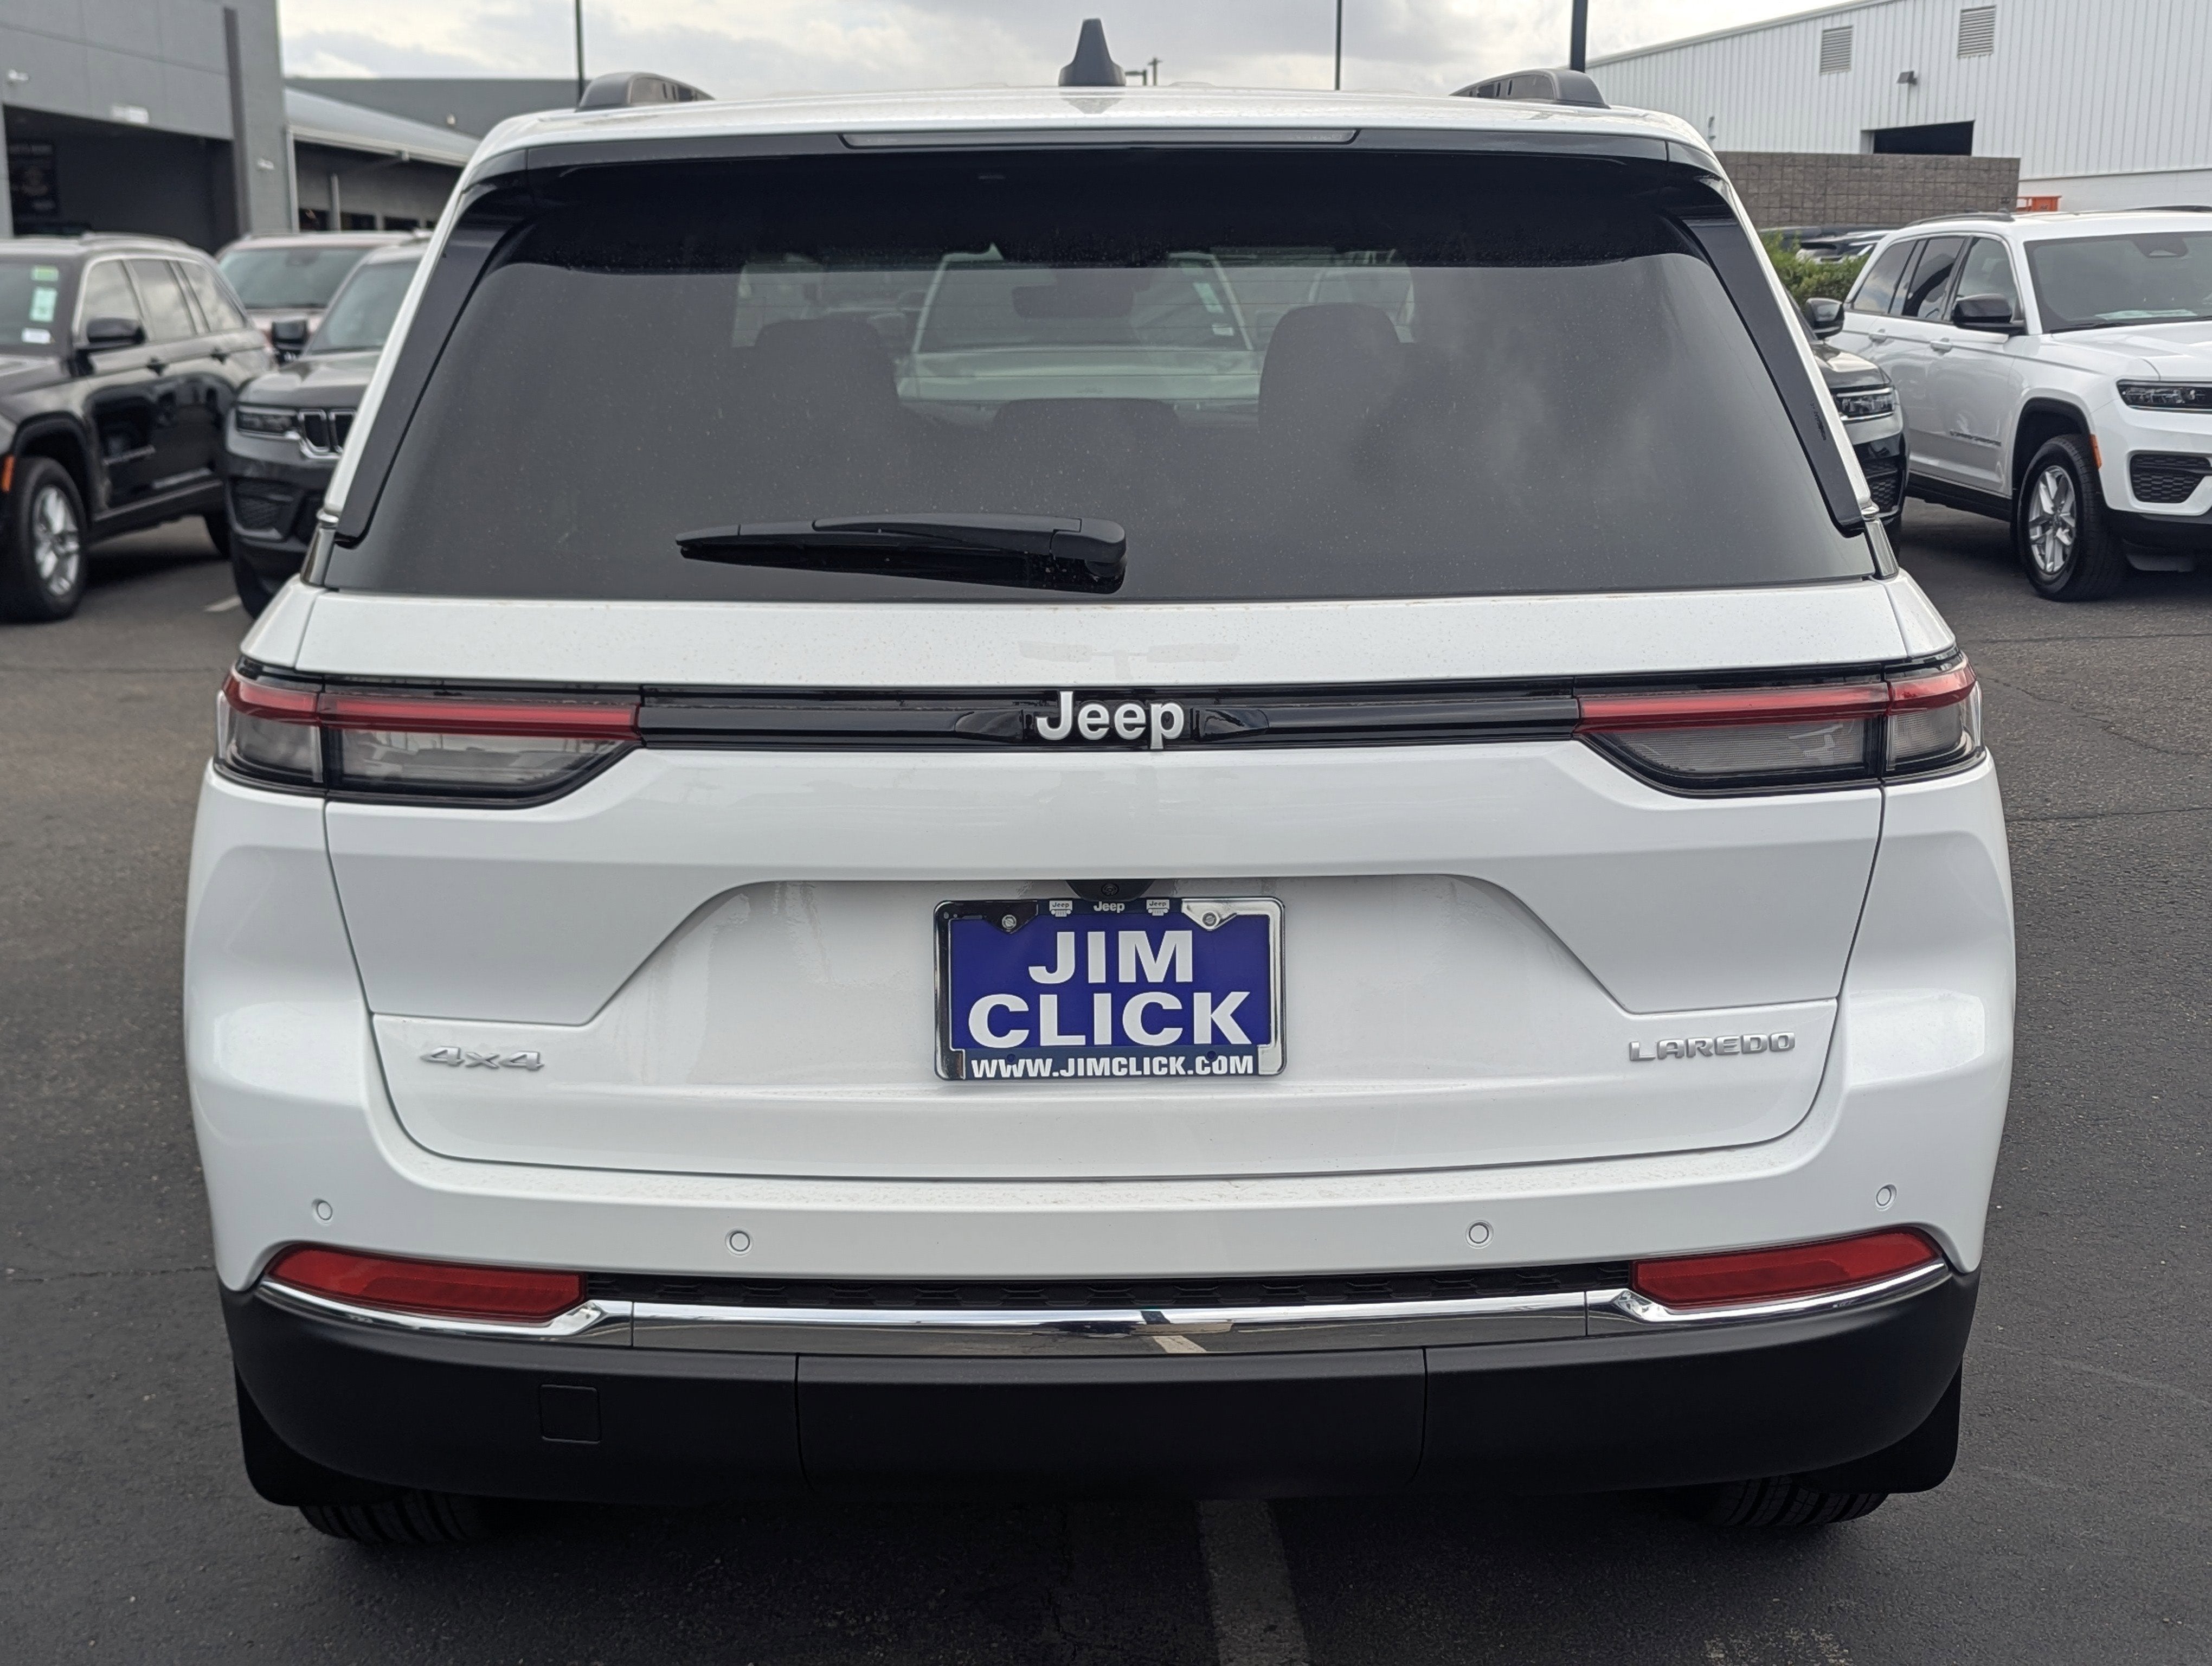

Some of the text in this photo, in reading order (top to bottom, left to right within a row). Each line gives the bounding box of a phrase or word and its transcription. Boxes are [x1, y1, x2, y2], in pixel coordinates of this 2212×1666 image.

[1036, 691, 1184, 749] Jeep
[1093, 901, 1125, 913] Jeep
[1028, 930, 1193, 984] JIM
[968, 991, 1252, 1048] CLICK
[420, 1045, 545, 1071] 4x4
[1629, 1031, 1795, 1061] LAREDO
[971, 1055, 1253, 1078] WWW.JIMCLICK.COM
